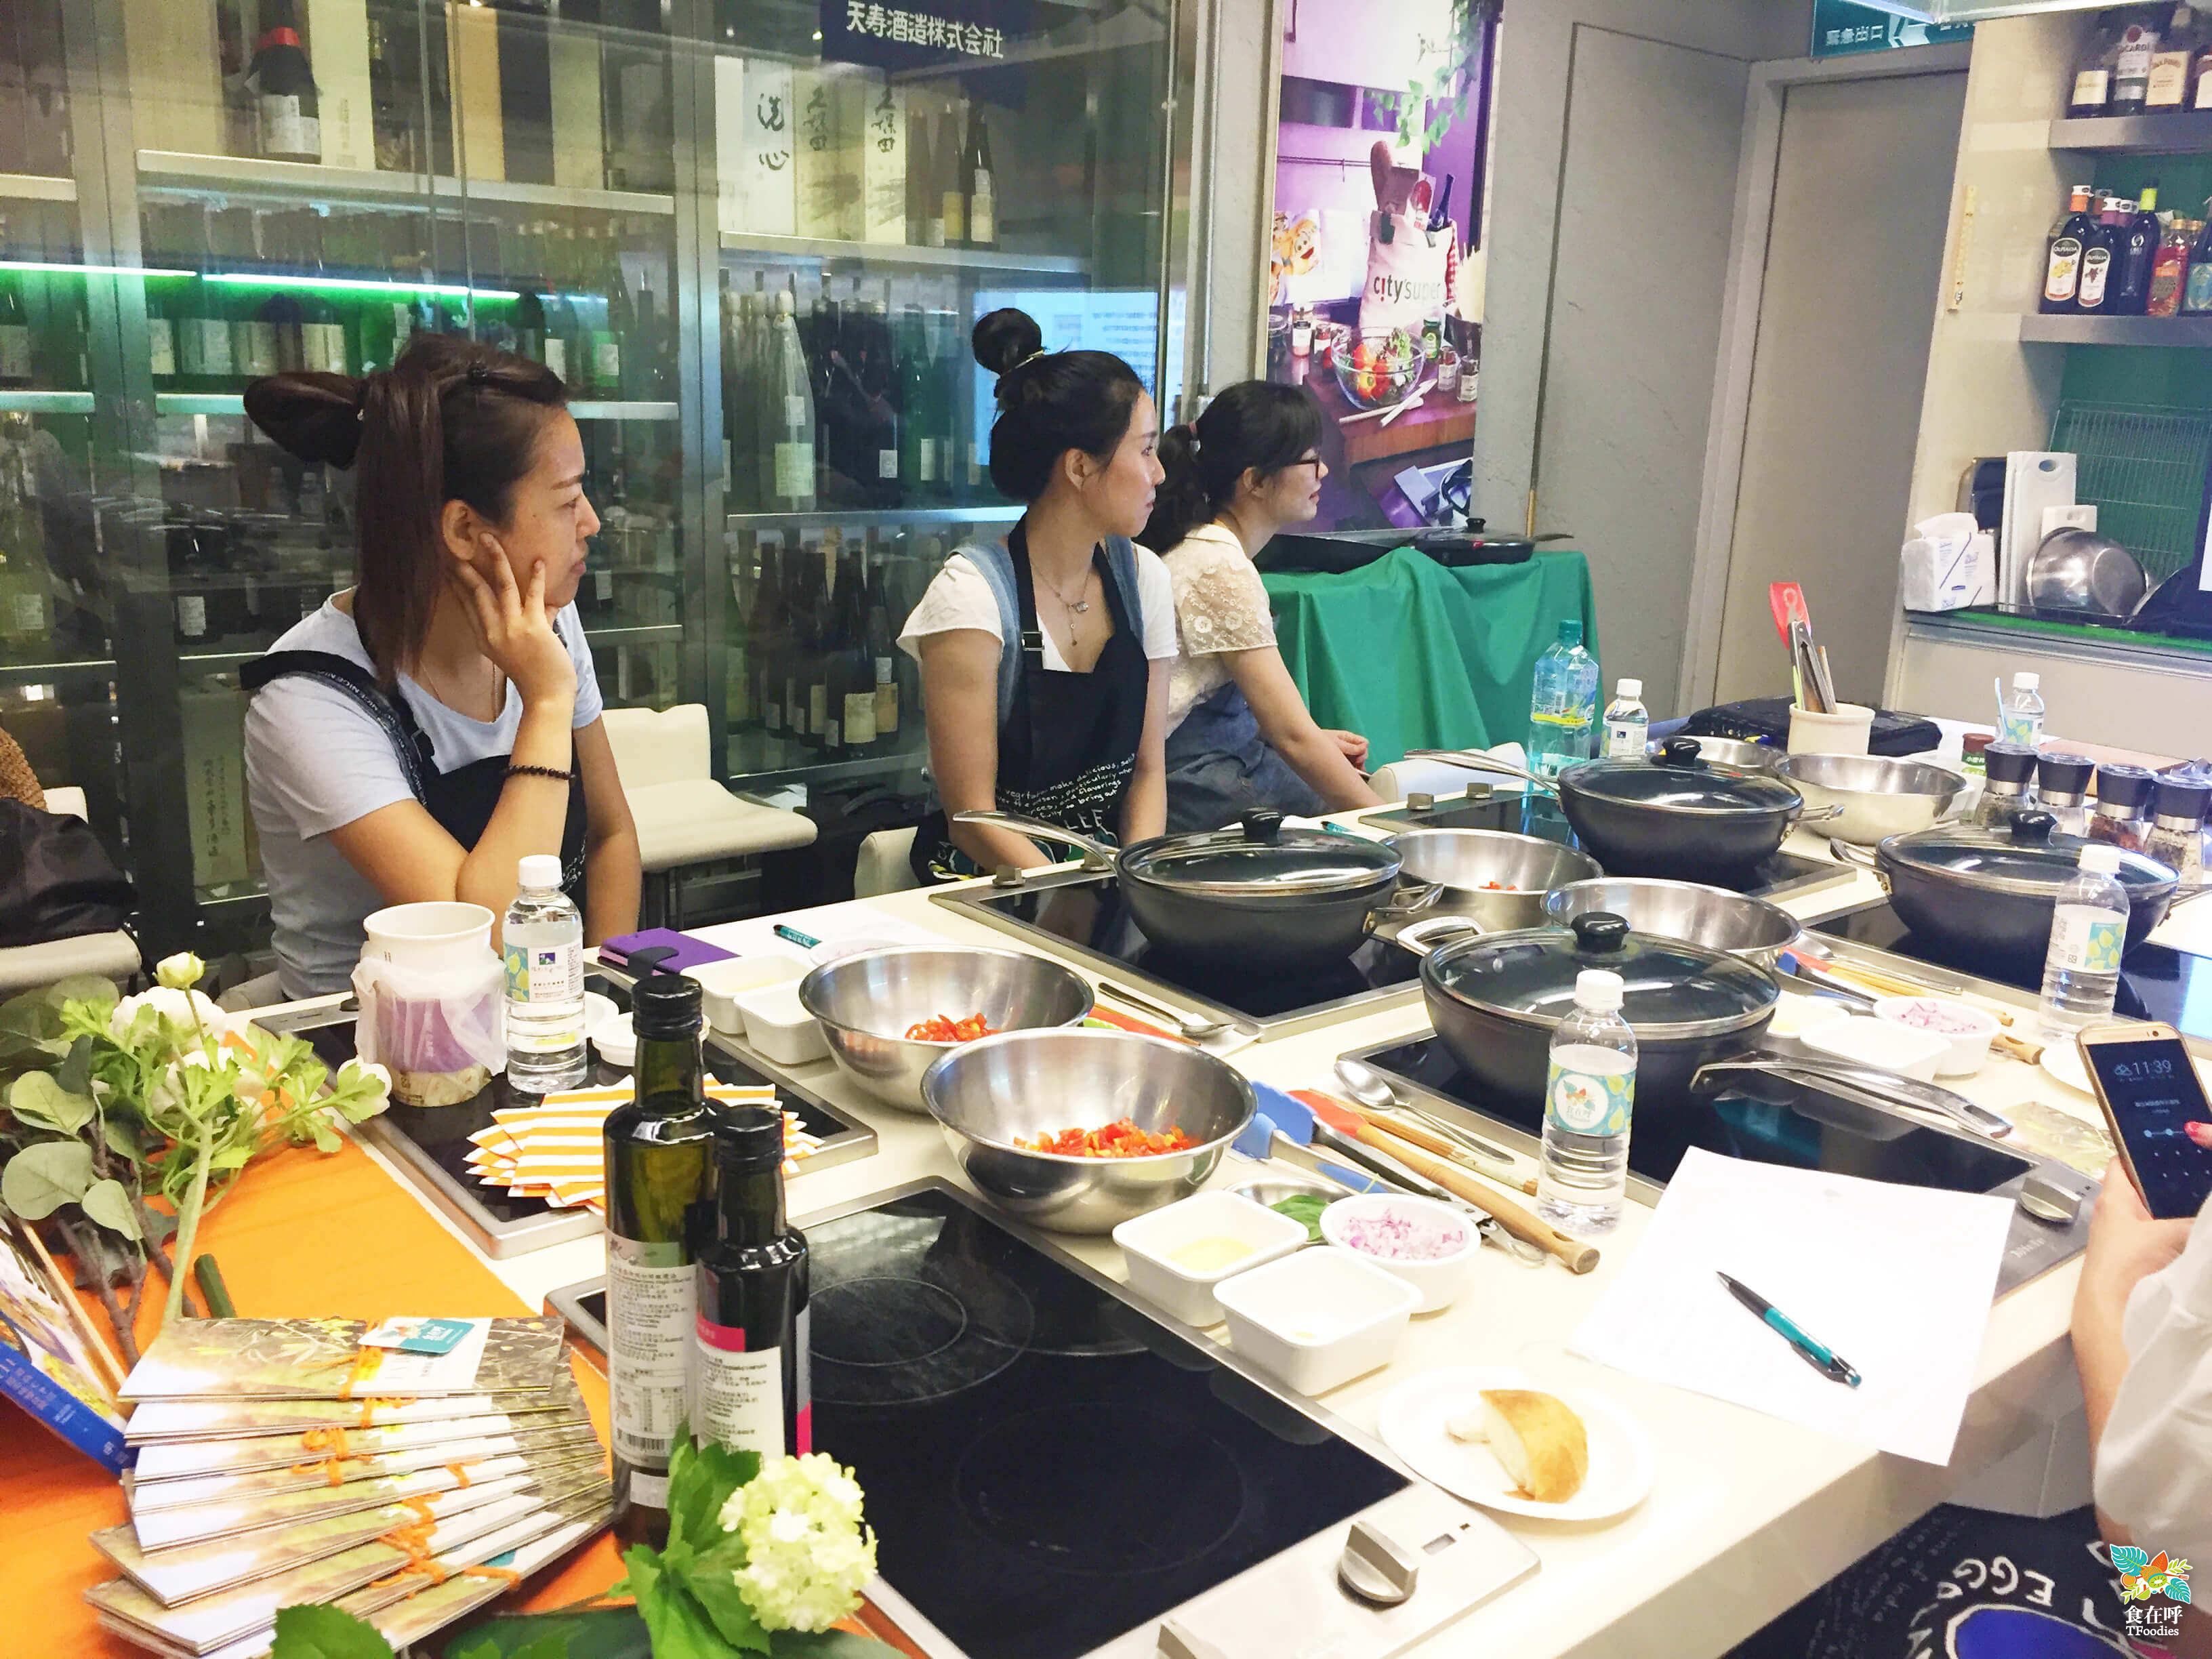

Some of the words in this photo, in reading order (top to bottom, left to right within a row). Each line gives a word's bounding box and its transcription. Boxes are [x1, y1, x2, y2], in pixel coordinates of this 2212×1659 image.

[846, 0, 1004, 59] 天寿酒造株式会社
[1050, 780, 1074, 790] make
[1078, 791, 1105, 804] bring
